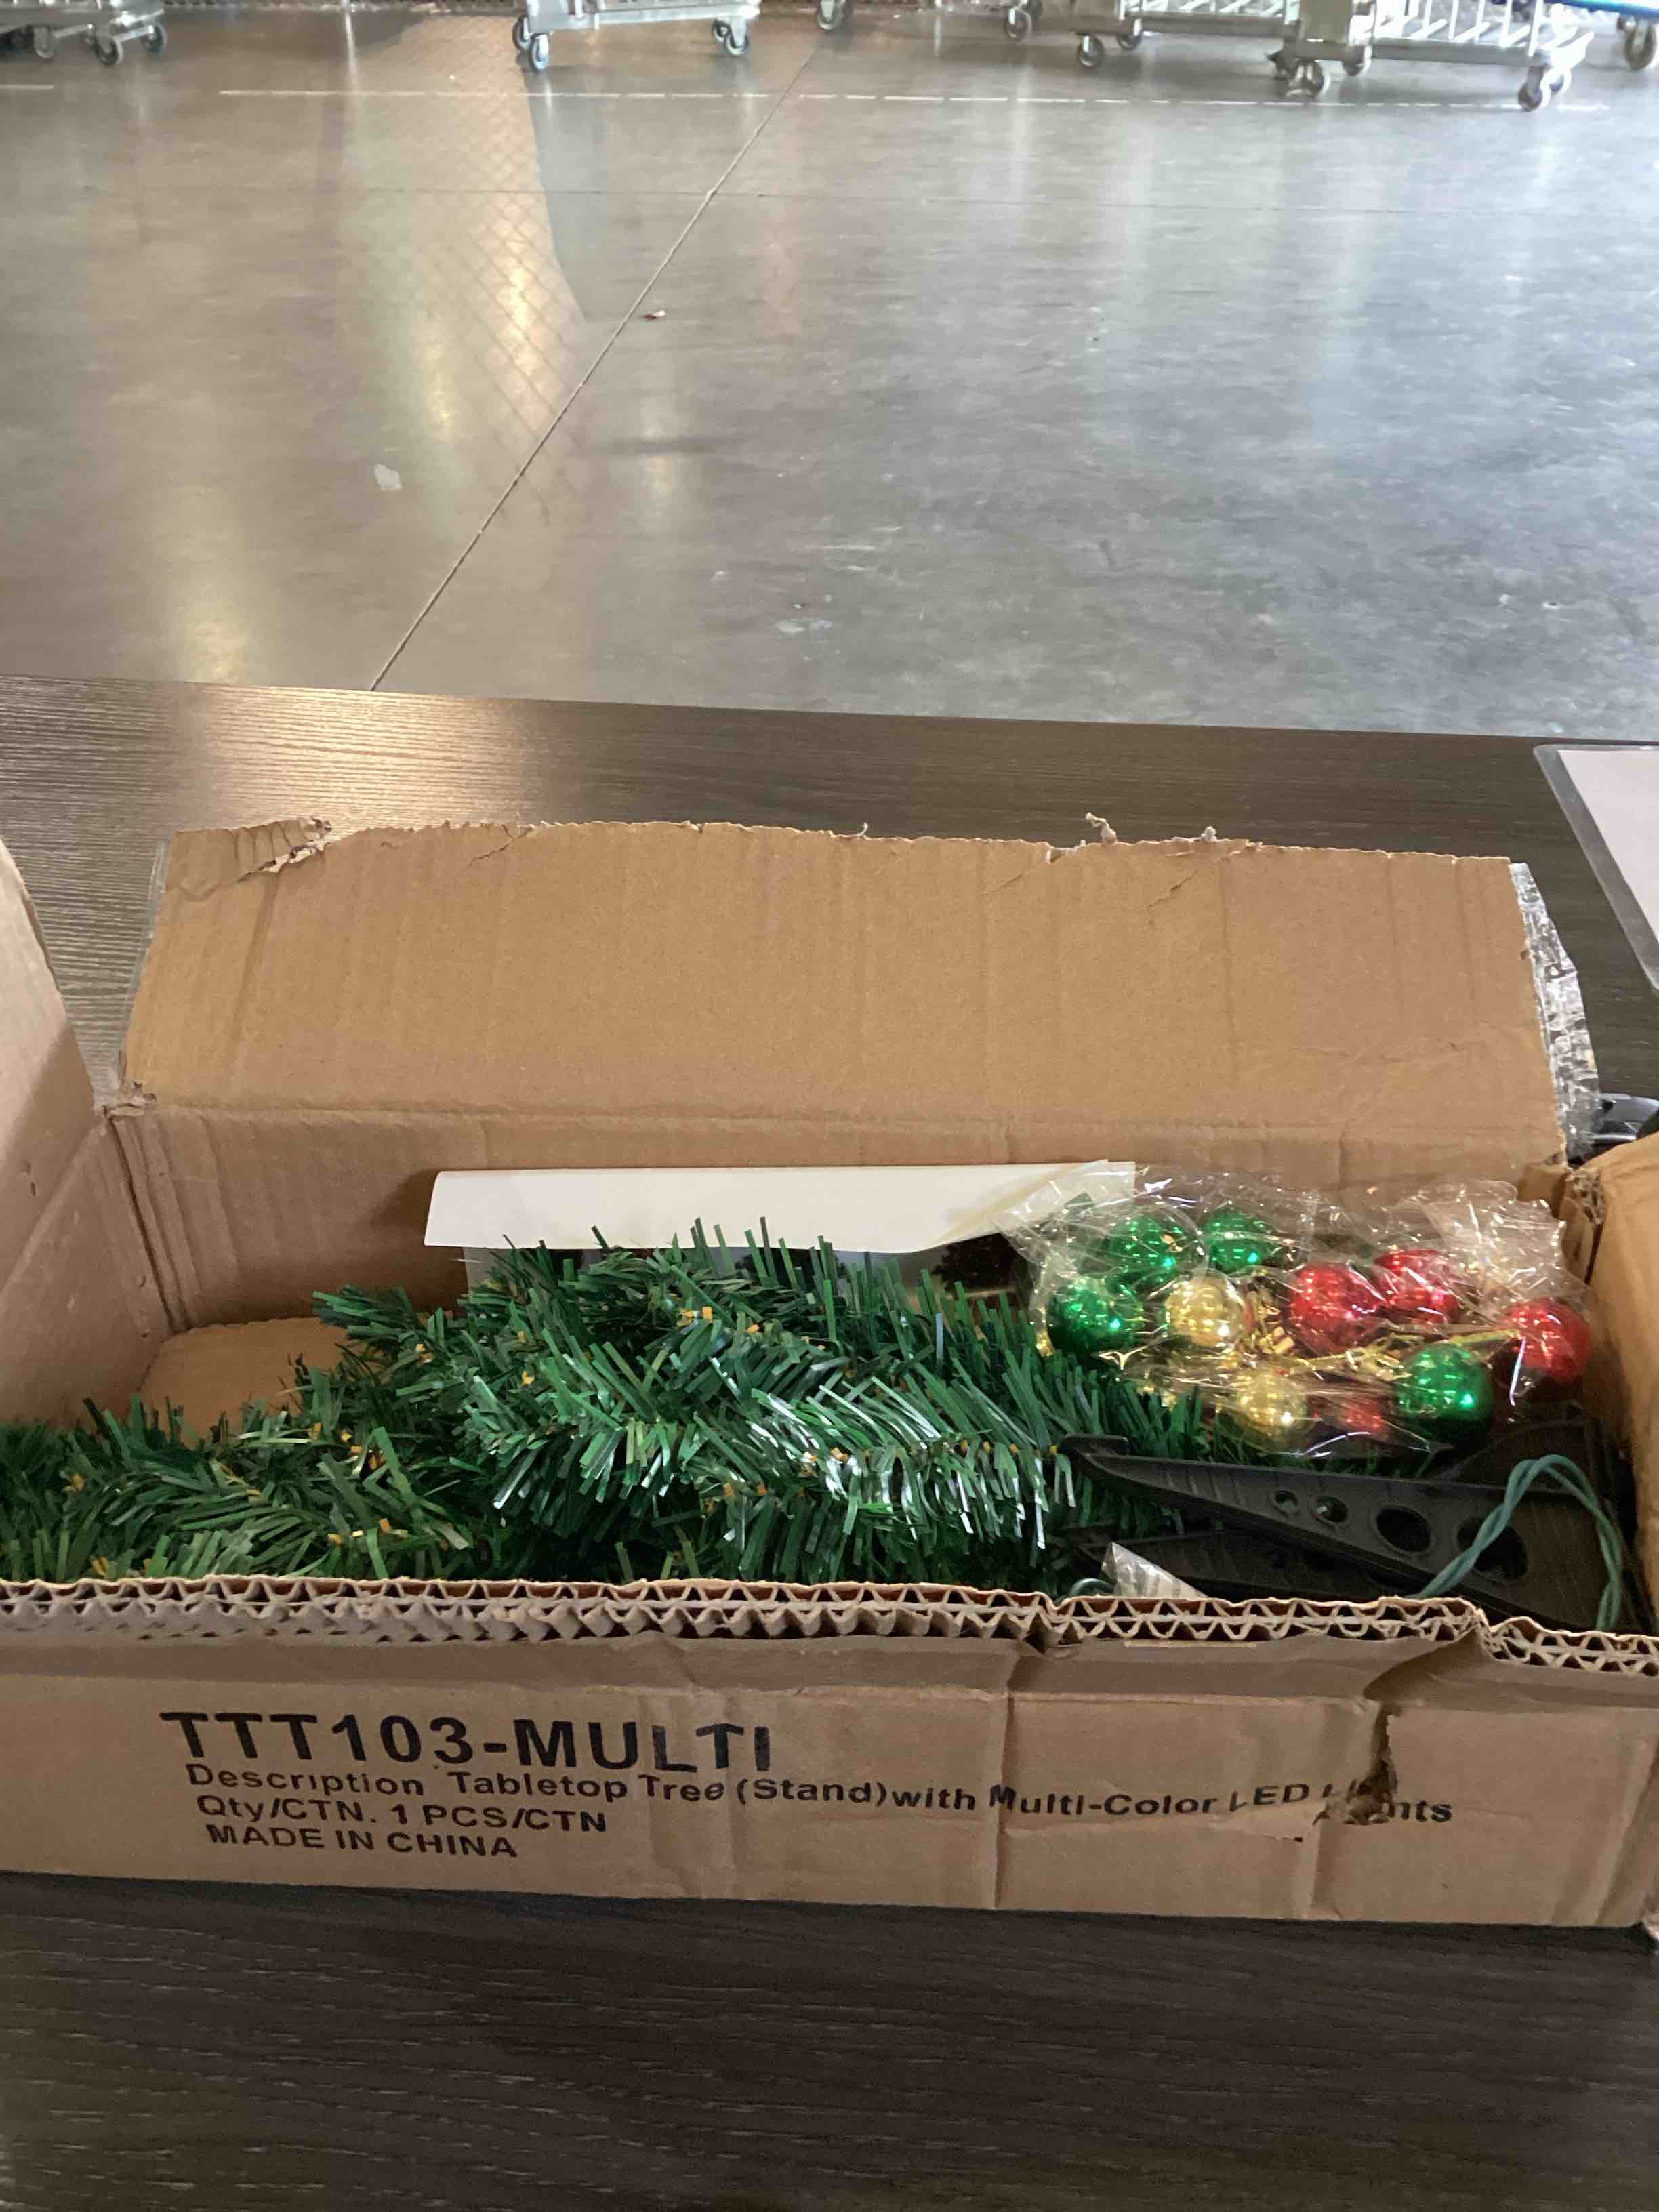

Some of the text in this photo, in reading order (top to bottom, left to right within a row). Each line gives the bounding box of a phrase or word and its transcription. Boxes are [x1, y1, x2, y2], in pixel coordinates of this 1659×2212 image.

[159, 1711, 771, 1774] TTT103-MULTI
[185, 1763, 425, 1797] Description
[446, 1769, 628, 1803] Tabletop
[638, 1774, 725, 1802] Tree
[989, 1783, 1218, 1816] Multi-Color
[1229, 1783, 1310, 1813] LED
[390, 1803, 409, 1825] 1
[422, 1804, 607, 1832] PCS/CTN
[205, 1823, 518, 1858] MADE IN CHINA
